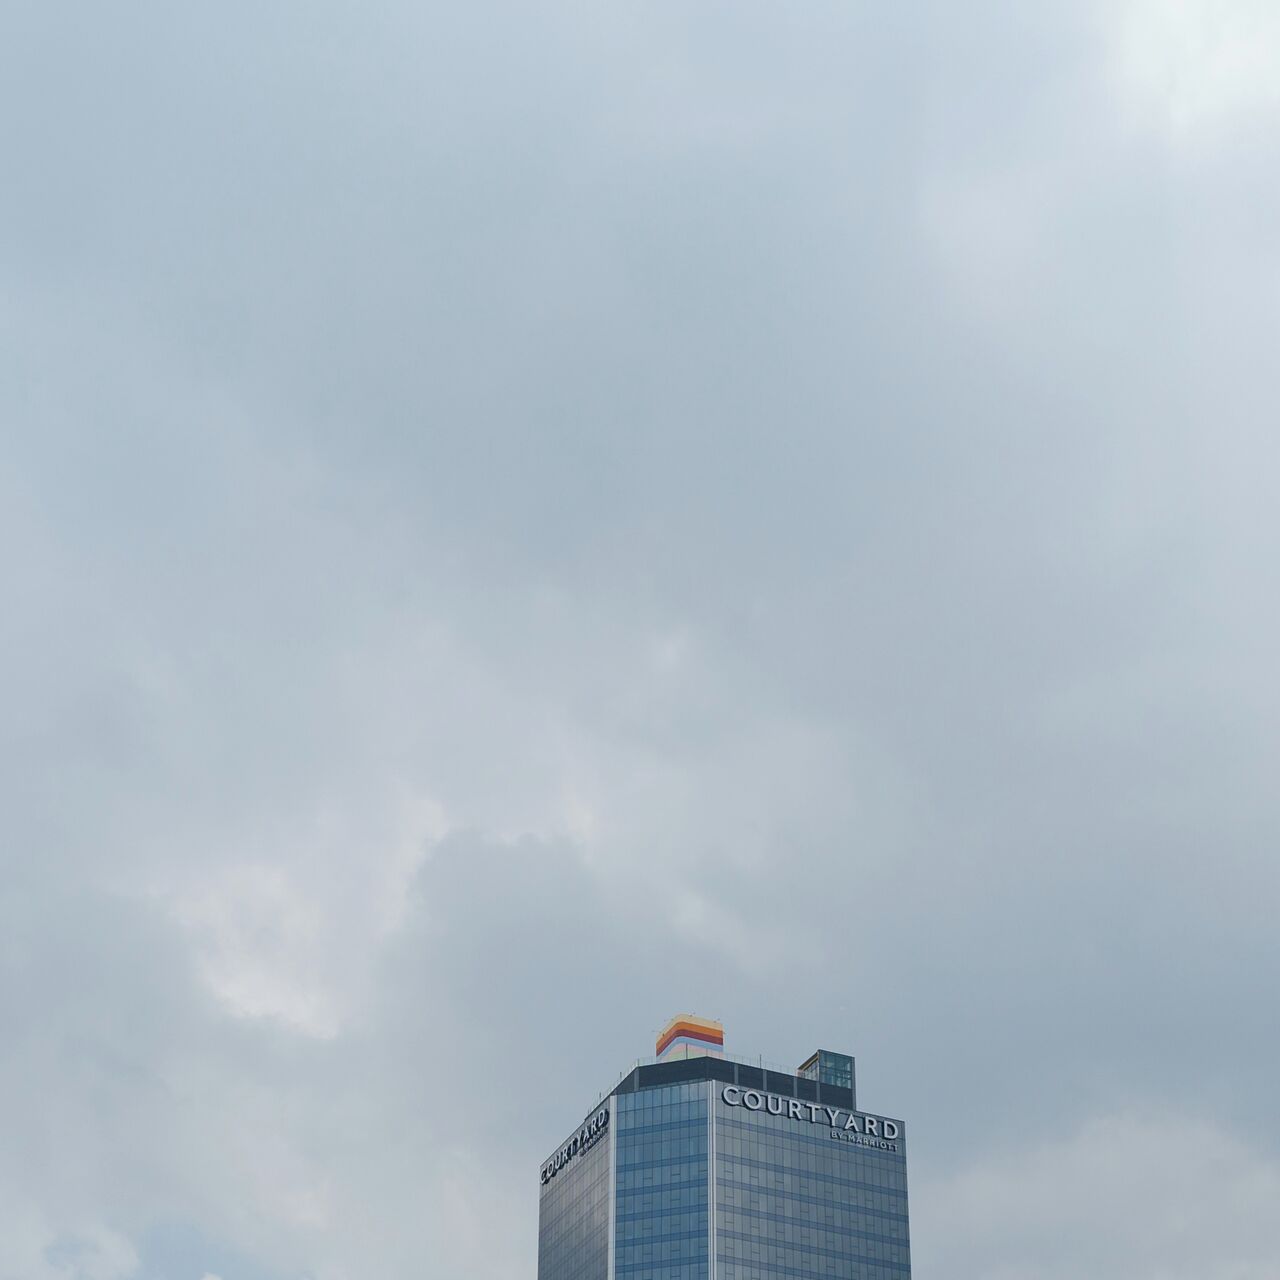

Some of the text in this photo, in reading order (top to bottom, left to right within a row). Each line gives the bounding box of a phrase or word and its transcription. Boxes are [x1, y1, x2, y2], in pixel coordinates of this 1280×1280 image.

[722, 1086, 899, 1140] COURTYARD
[540, 1109, 607, 1184] COURTYARD
[831, 1131, 898, 1151] BY MARRIOTT
